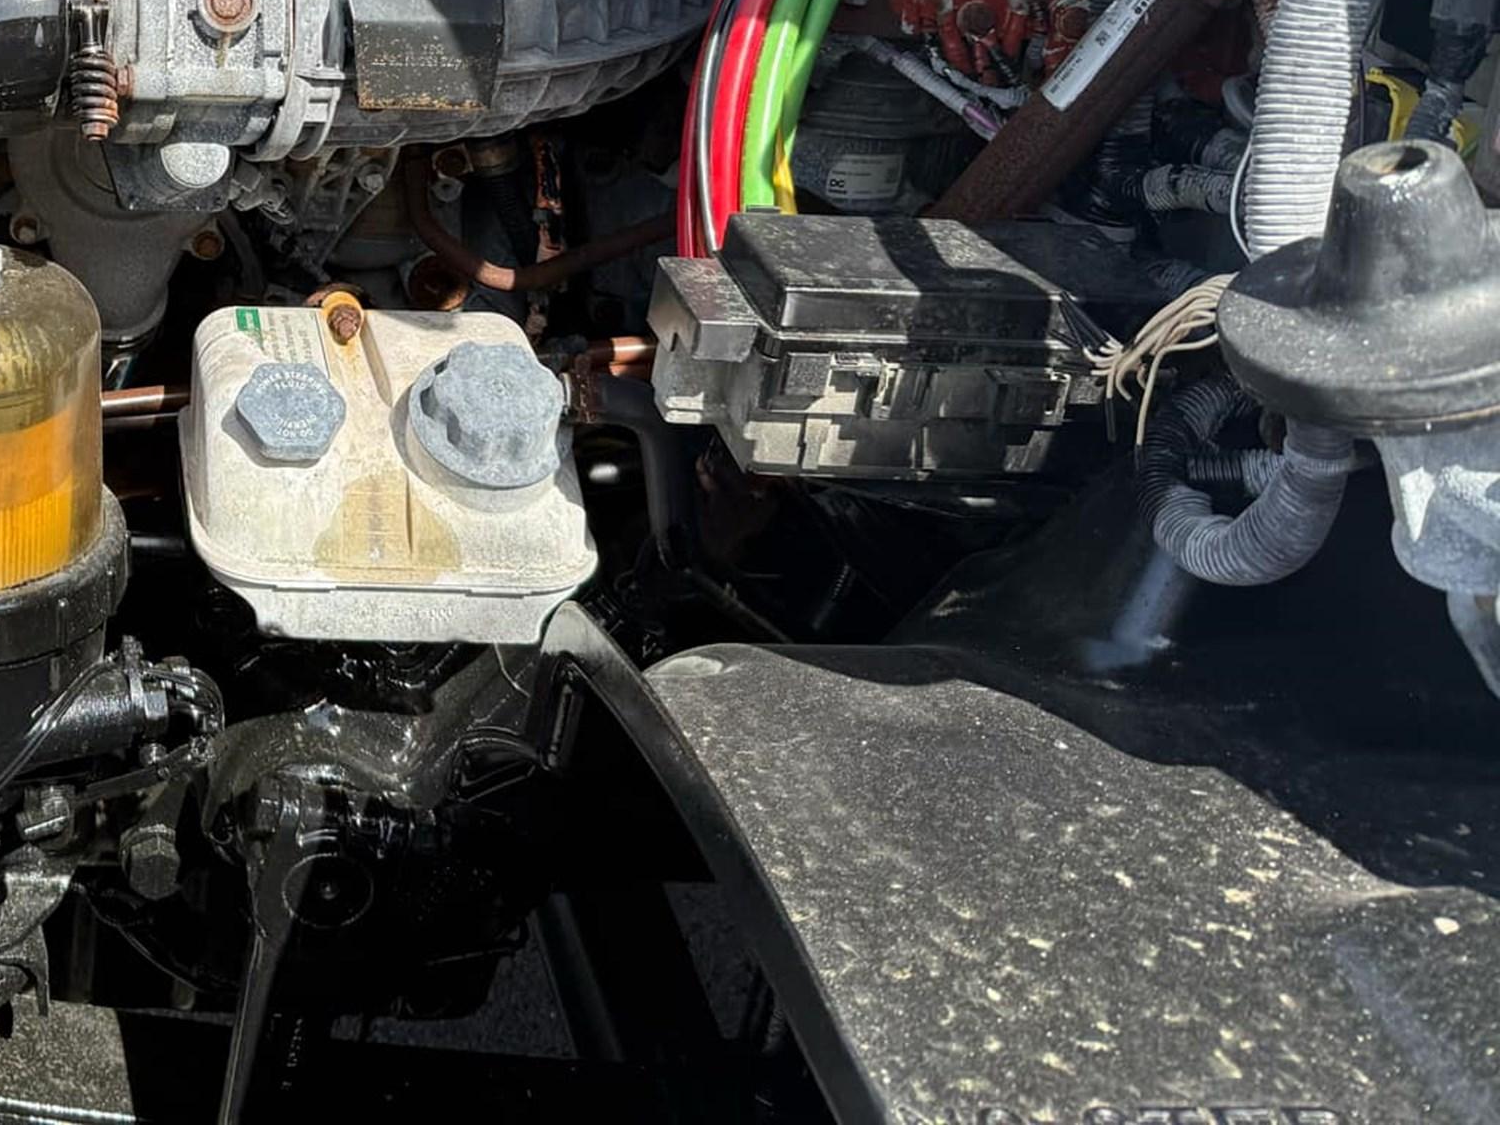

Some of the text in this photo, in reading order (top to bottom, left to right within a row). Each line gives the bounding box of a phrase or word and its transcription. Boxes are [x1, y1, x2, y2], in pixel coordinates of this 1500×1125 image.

[256, 371, 328, 395] POWER STEERING
[274, 380, 308, 390] FLUID
